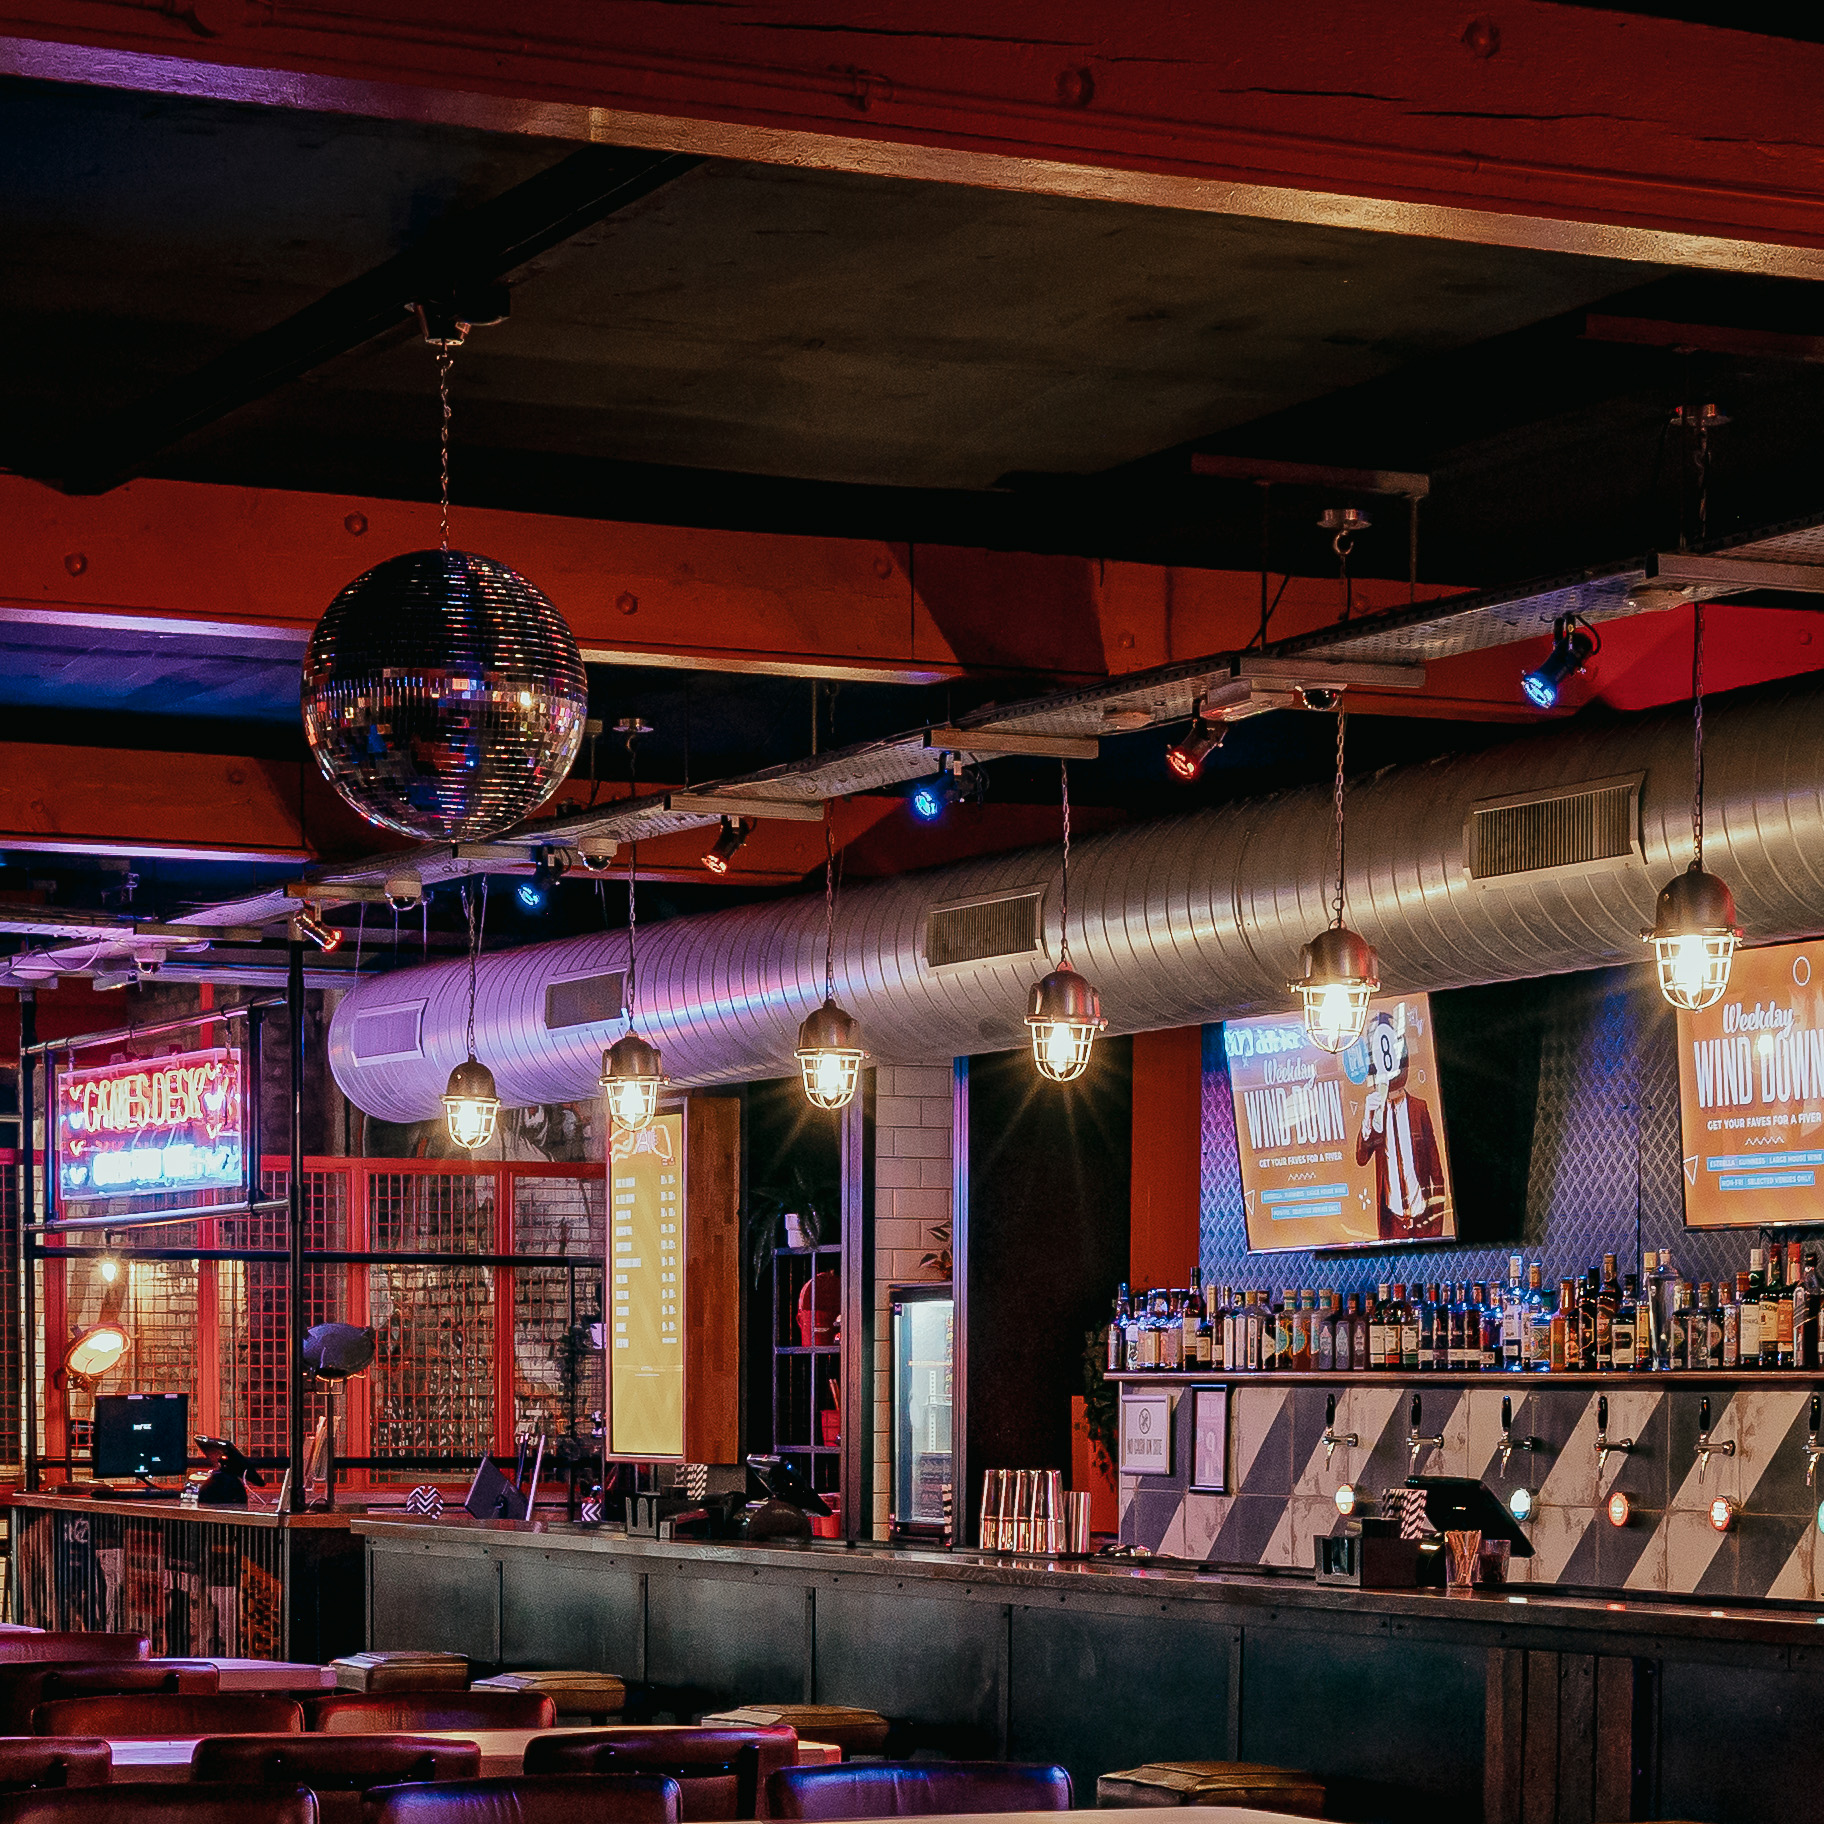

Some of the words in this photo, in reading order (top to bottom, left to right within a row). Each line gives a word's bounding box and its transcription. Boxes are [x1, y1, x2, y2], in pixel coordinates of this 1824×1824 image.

[1723, 1001, 1794, 1037] Weekday
[1263, 1057, 1317, 1086] Weekday
[1380, 1034, 1393, 1072] 8
[1693, 1037, 1753, 1108] WIND
[1244, 1088, 1292, 1149] WIND
[1291, 1080, 1345, 1145] DOWN
[1707, 1120, 1722, 1131] GET
[1724, 1118, 1745, 1129] YOUR
[1747, 1116, 1771, 1128] FAVES
[1773, 1114, 1789, 1126] FOR
[1790, 1114, 1797, 1124] A
[1798, 1112, 1822, 1124] FIVER
